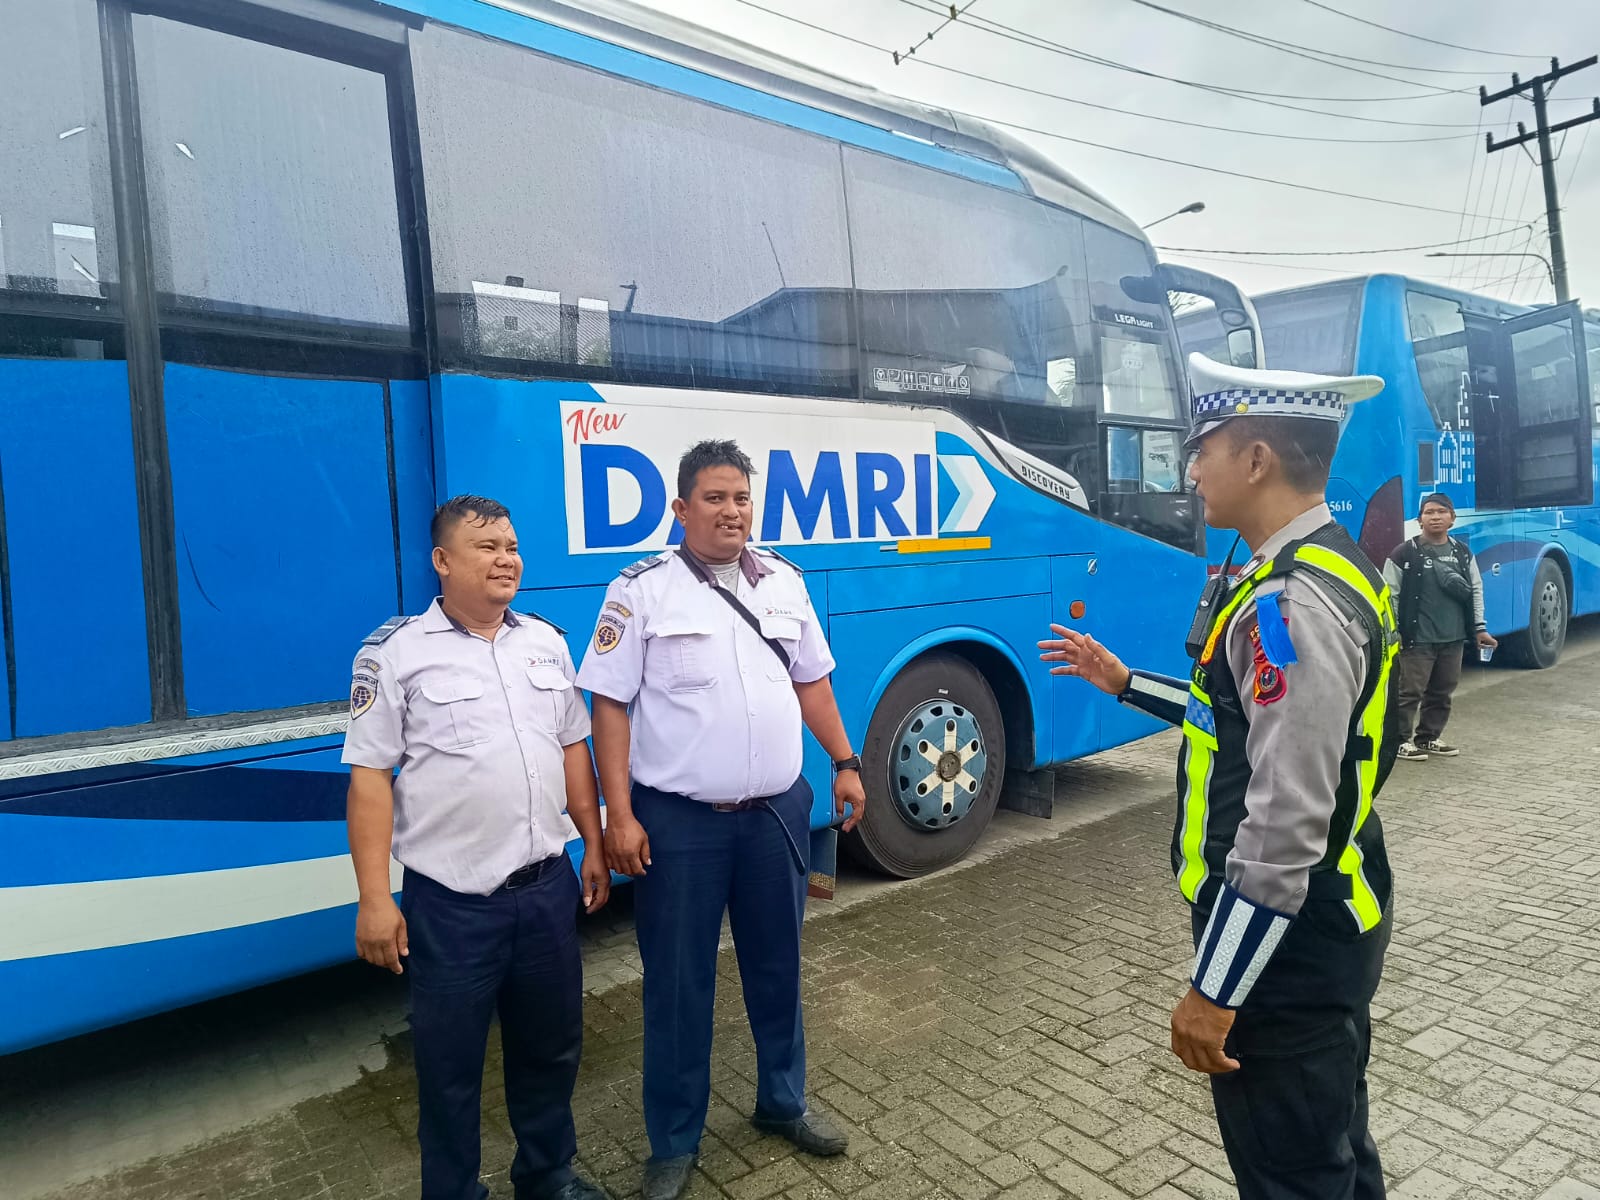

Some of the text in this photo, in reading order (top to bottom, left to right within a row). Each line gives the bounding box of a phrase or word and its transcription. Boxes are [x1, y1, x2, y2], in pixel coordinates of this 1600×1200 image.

[566, 408, 627, 443] New
[580, 444, 931, 548] DMRI
[1021, 464, 1071, 500] DISCOVERY
